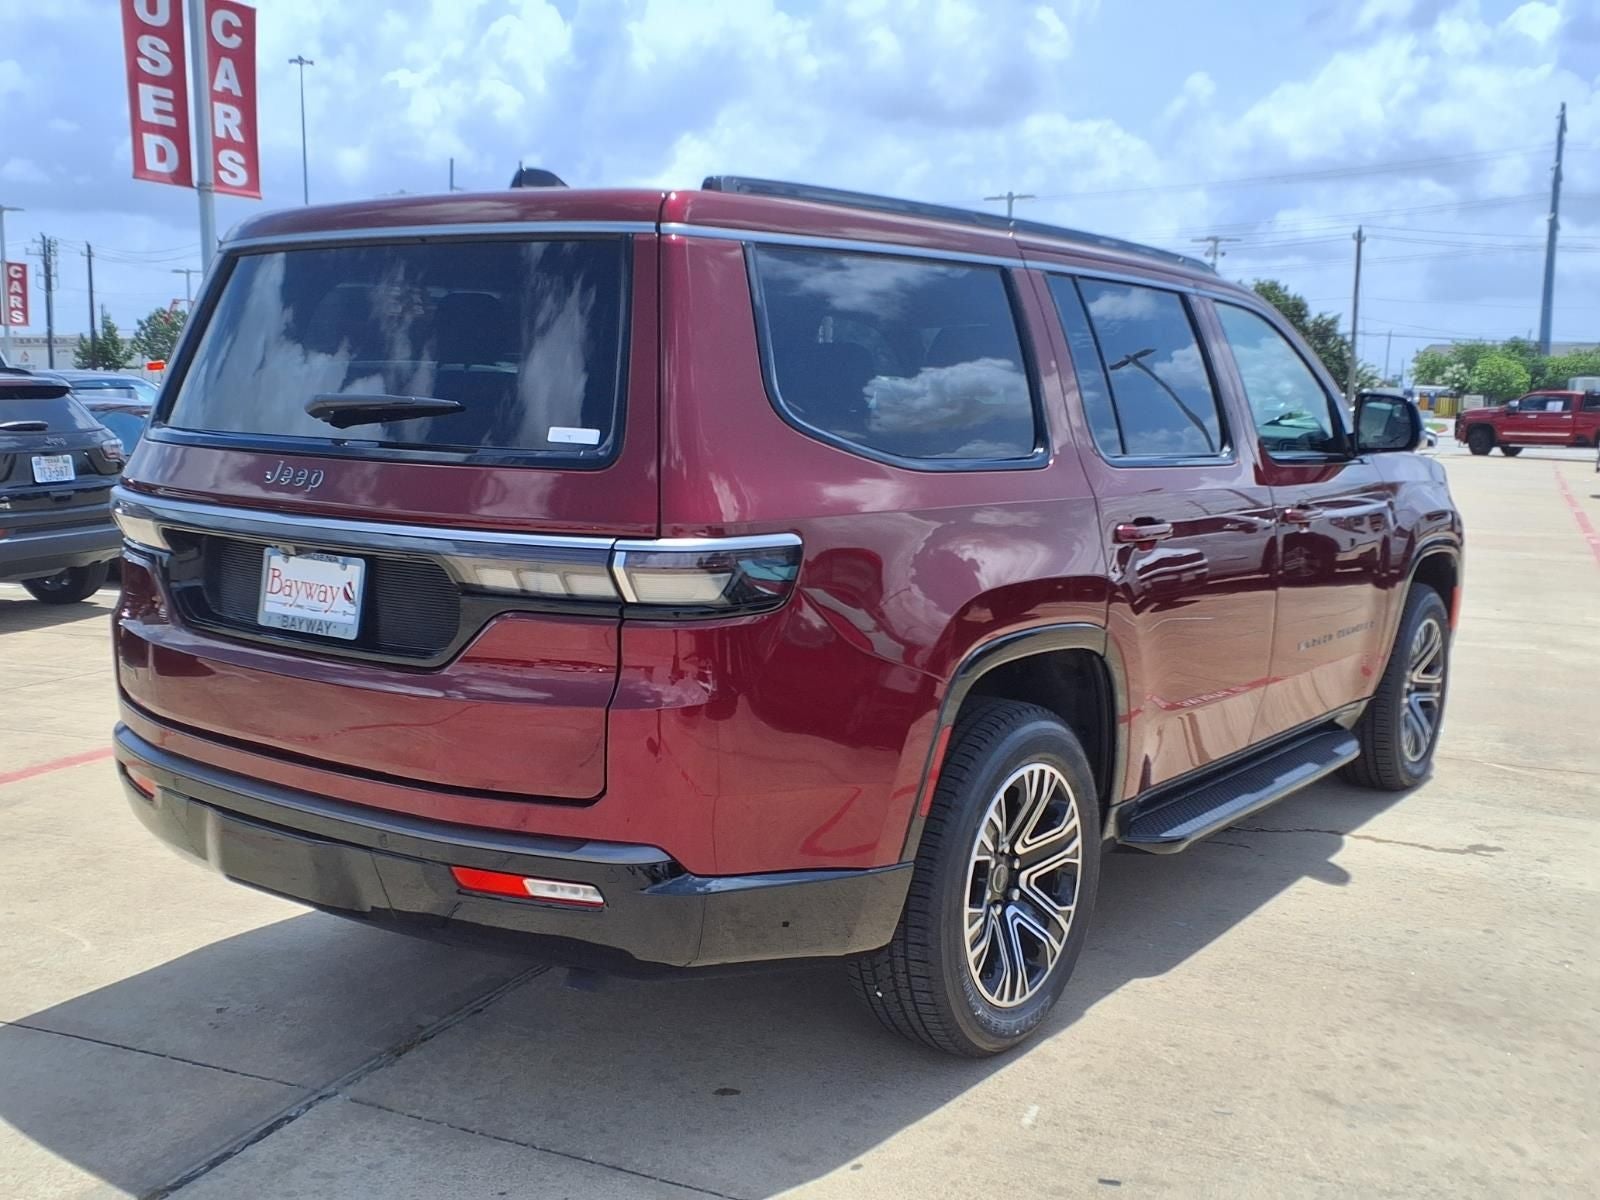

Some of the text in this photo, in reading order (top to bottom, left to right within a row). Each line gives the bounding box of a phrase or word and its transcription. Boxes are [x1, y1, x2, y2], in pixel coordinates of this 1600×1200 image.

[210, 9, 249, 187] CARS
[9, 265, 25, 323] CARS
[264, 460, 324, 492] Jeep
[266, 567, 340, 613] Bayway
[281, 615, 332, 634] BAYWAY
